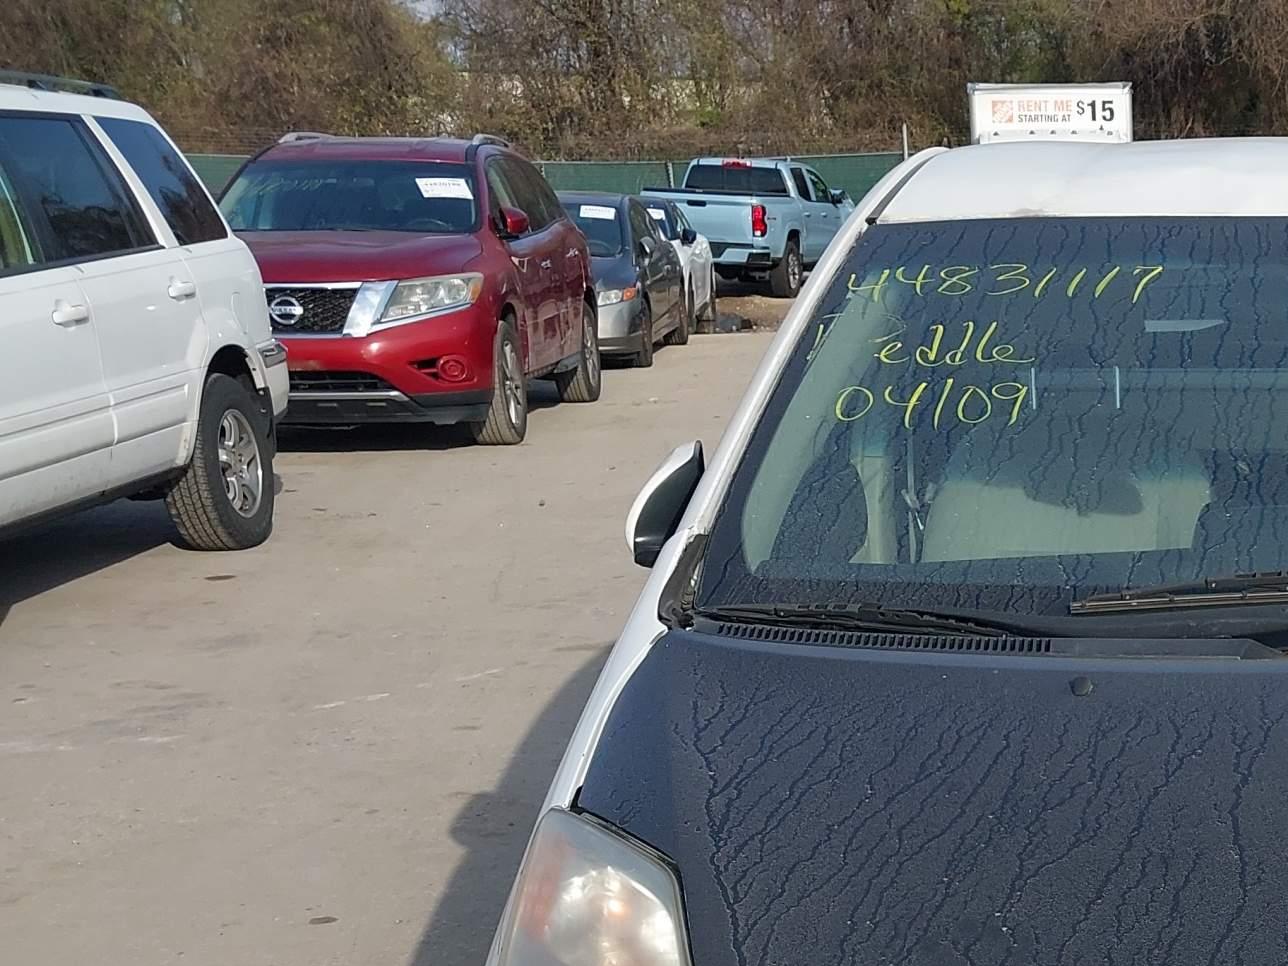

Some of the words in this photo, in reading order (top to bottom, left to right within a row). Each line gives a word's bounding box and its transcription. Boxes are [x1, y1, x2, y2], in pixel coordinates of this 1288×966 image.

[1017, 99, 1049, 112] RENT
[1054, 99, 1073, 112] ME
[1076, 99, 1115, 123] $15
[1017, 114, 1059, 123] STARTING
[1061, 114, 1071, 123] AT
[847, 262, 1164, 303] 44831117
[834, 377, 1029, 430] 04/09
